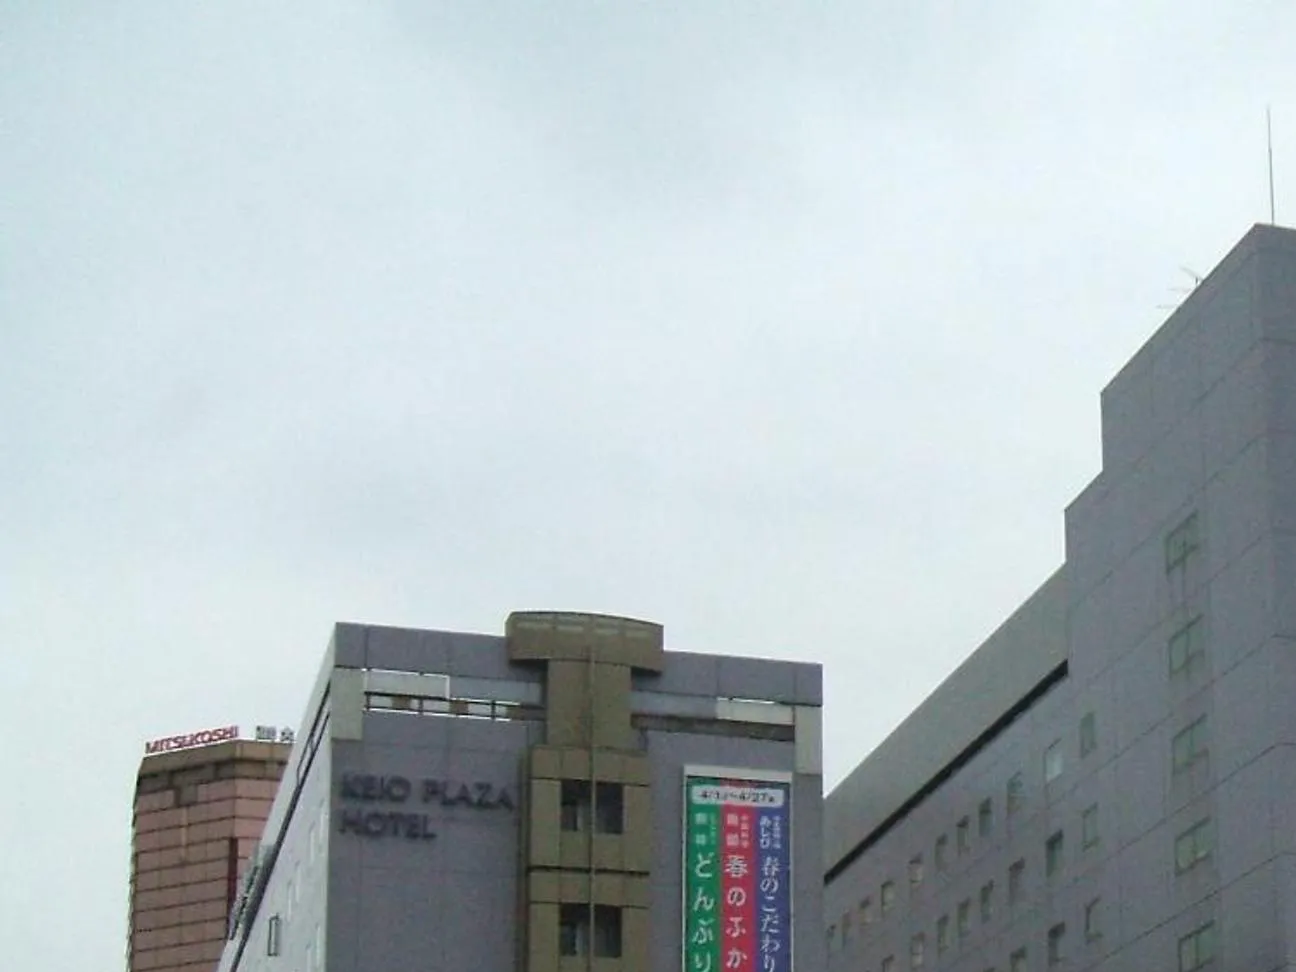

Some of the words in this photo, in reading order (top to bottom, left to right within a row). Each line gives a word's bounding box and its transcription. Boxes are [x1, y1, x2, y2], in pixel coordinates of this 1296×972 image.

[145, 724, 240, 754] MITSUKOSHI
[340, 772, 412, 803] KEIO
[422, 778, 515, 812] PLAZA
[338, 810, 438, 841] HOTEL
